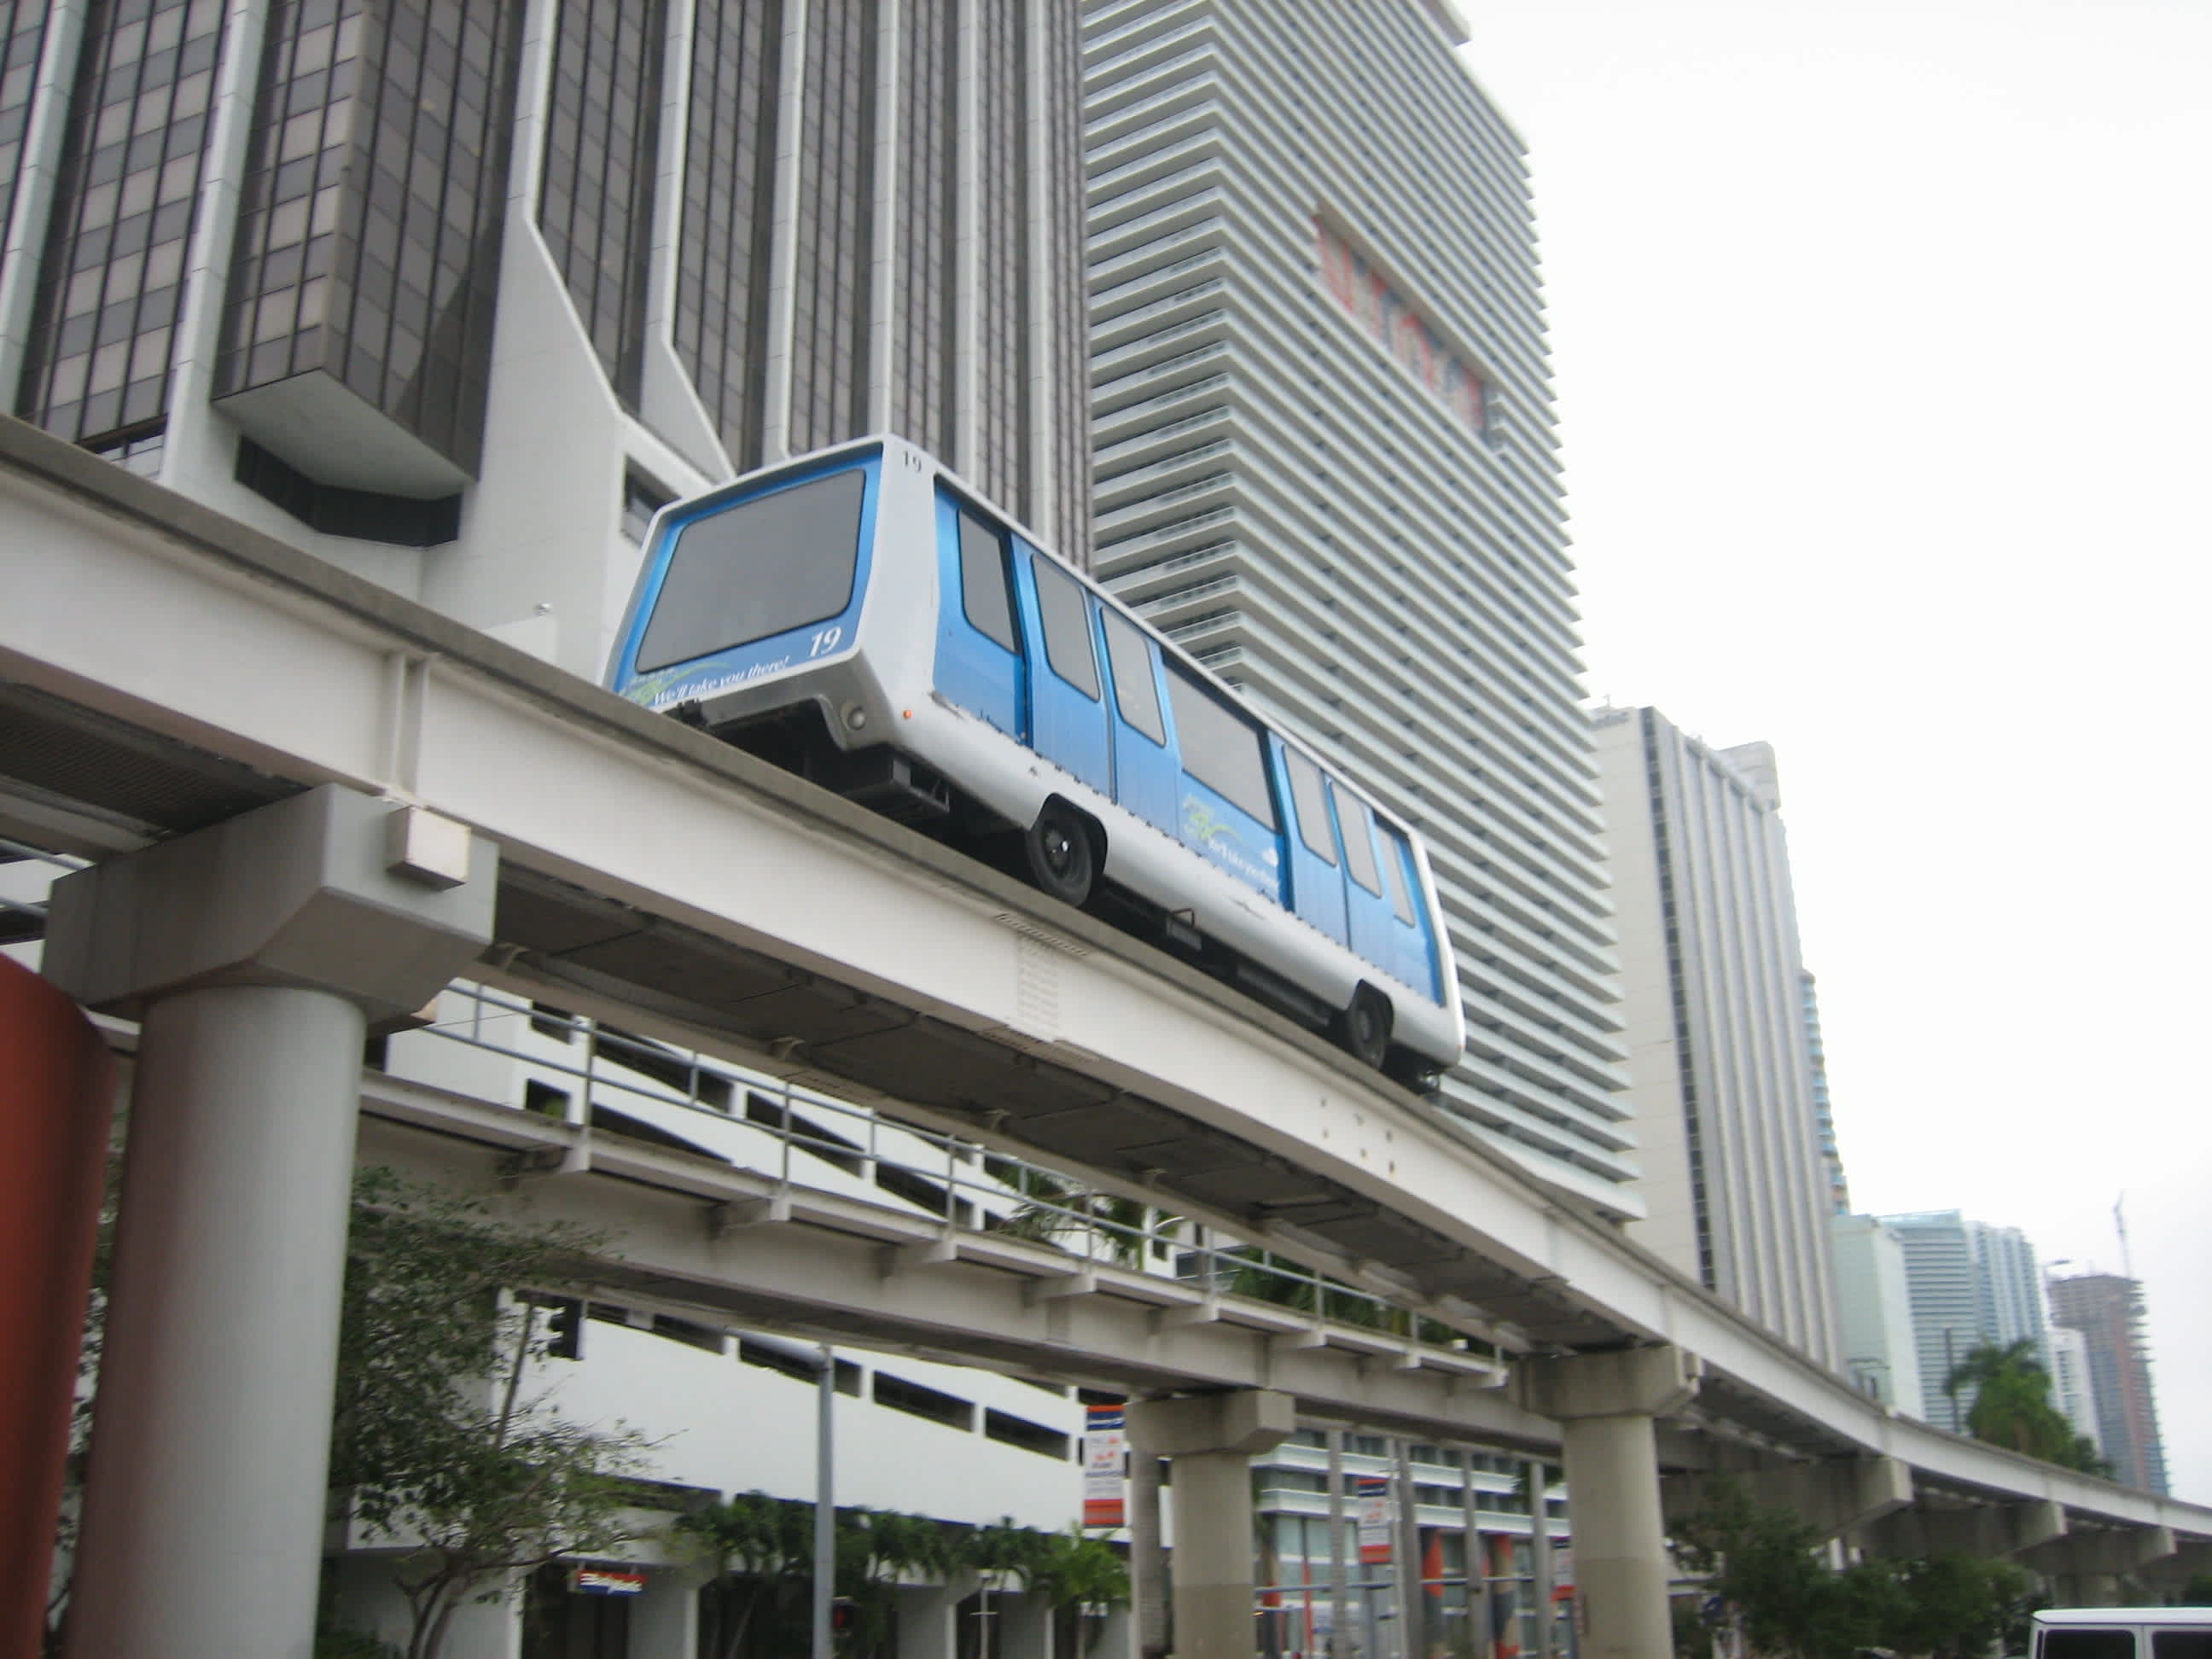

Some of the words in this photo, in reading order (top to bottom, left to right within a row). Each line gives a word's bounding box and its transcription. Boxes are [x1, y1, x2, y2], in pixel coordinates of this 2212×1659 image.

[904, 451, 922, 473] 19
[808, 627, 841, 657] 19
[654, 684, 688, 704] We'll
[688, 679, 713, 694] take
[716, 672, 743, 687] you
[747, 655, 789, 678] there!
